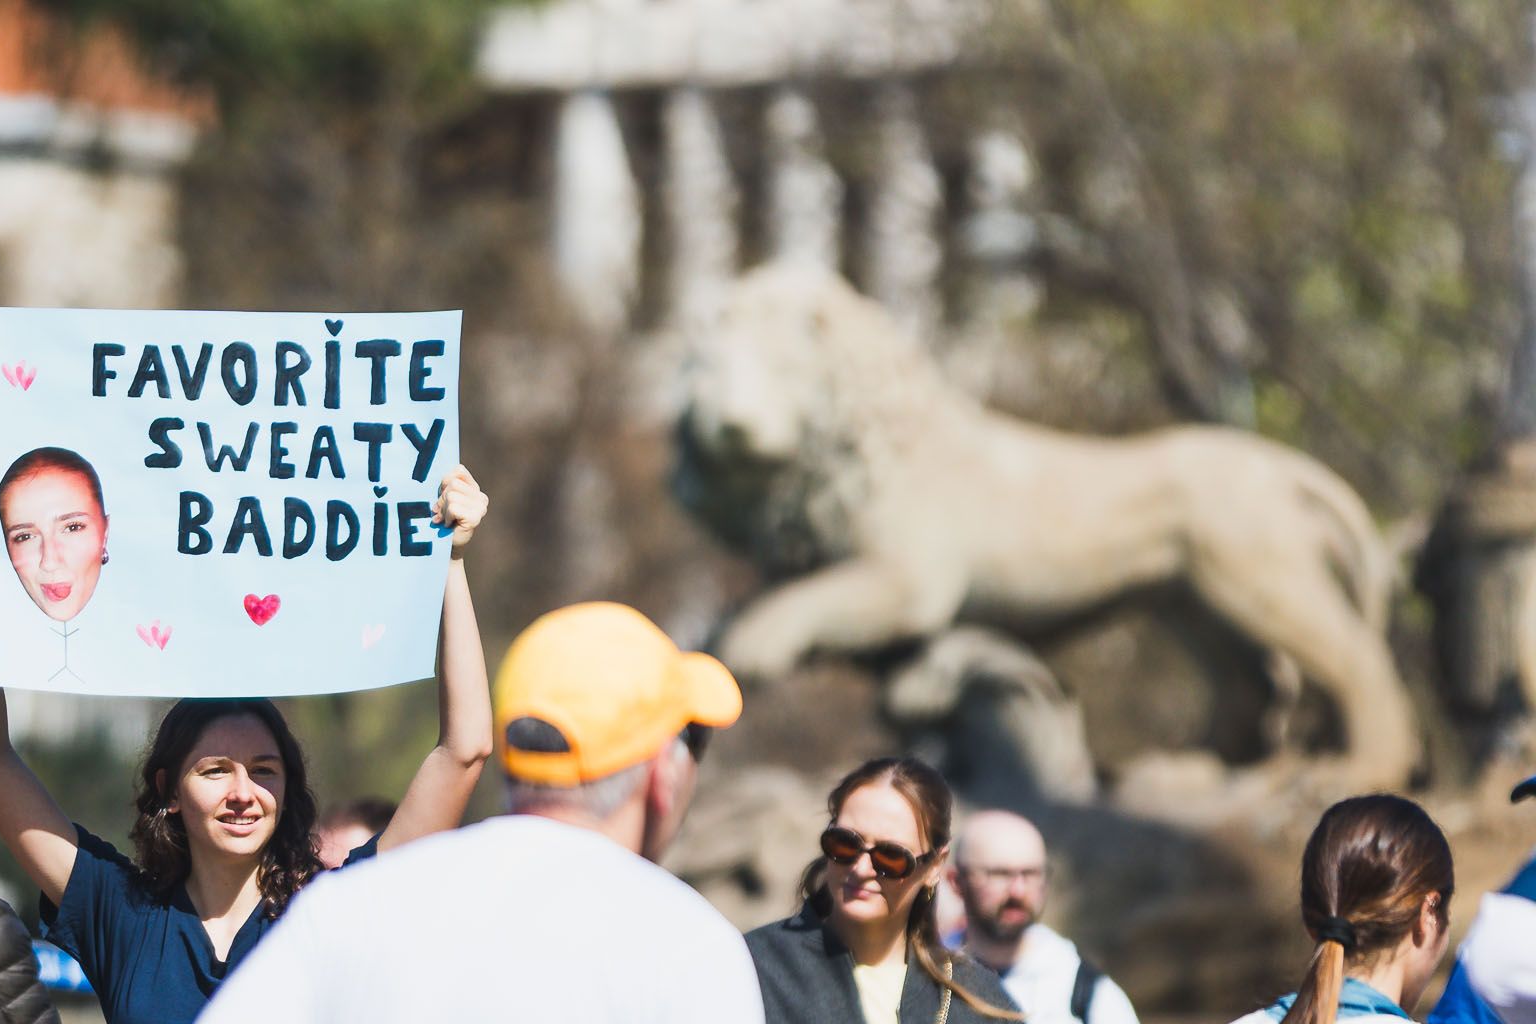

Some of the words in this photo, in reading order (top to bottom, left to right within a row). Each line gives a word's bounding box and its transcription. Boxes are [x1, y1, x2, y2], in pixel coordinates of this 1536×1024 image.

[92, 319, 446, 410] FAVORITE
[144, 417, 445, 483] SWEATY
[177, 486, 434, 562] BADDIE
